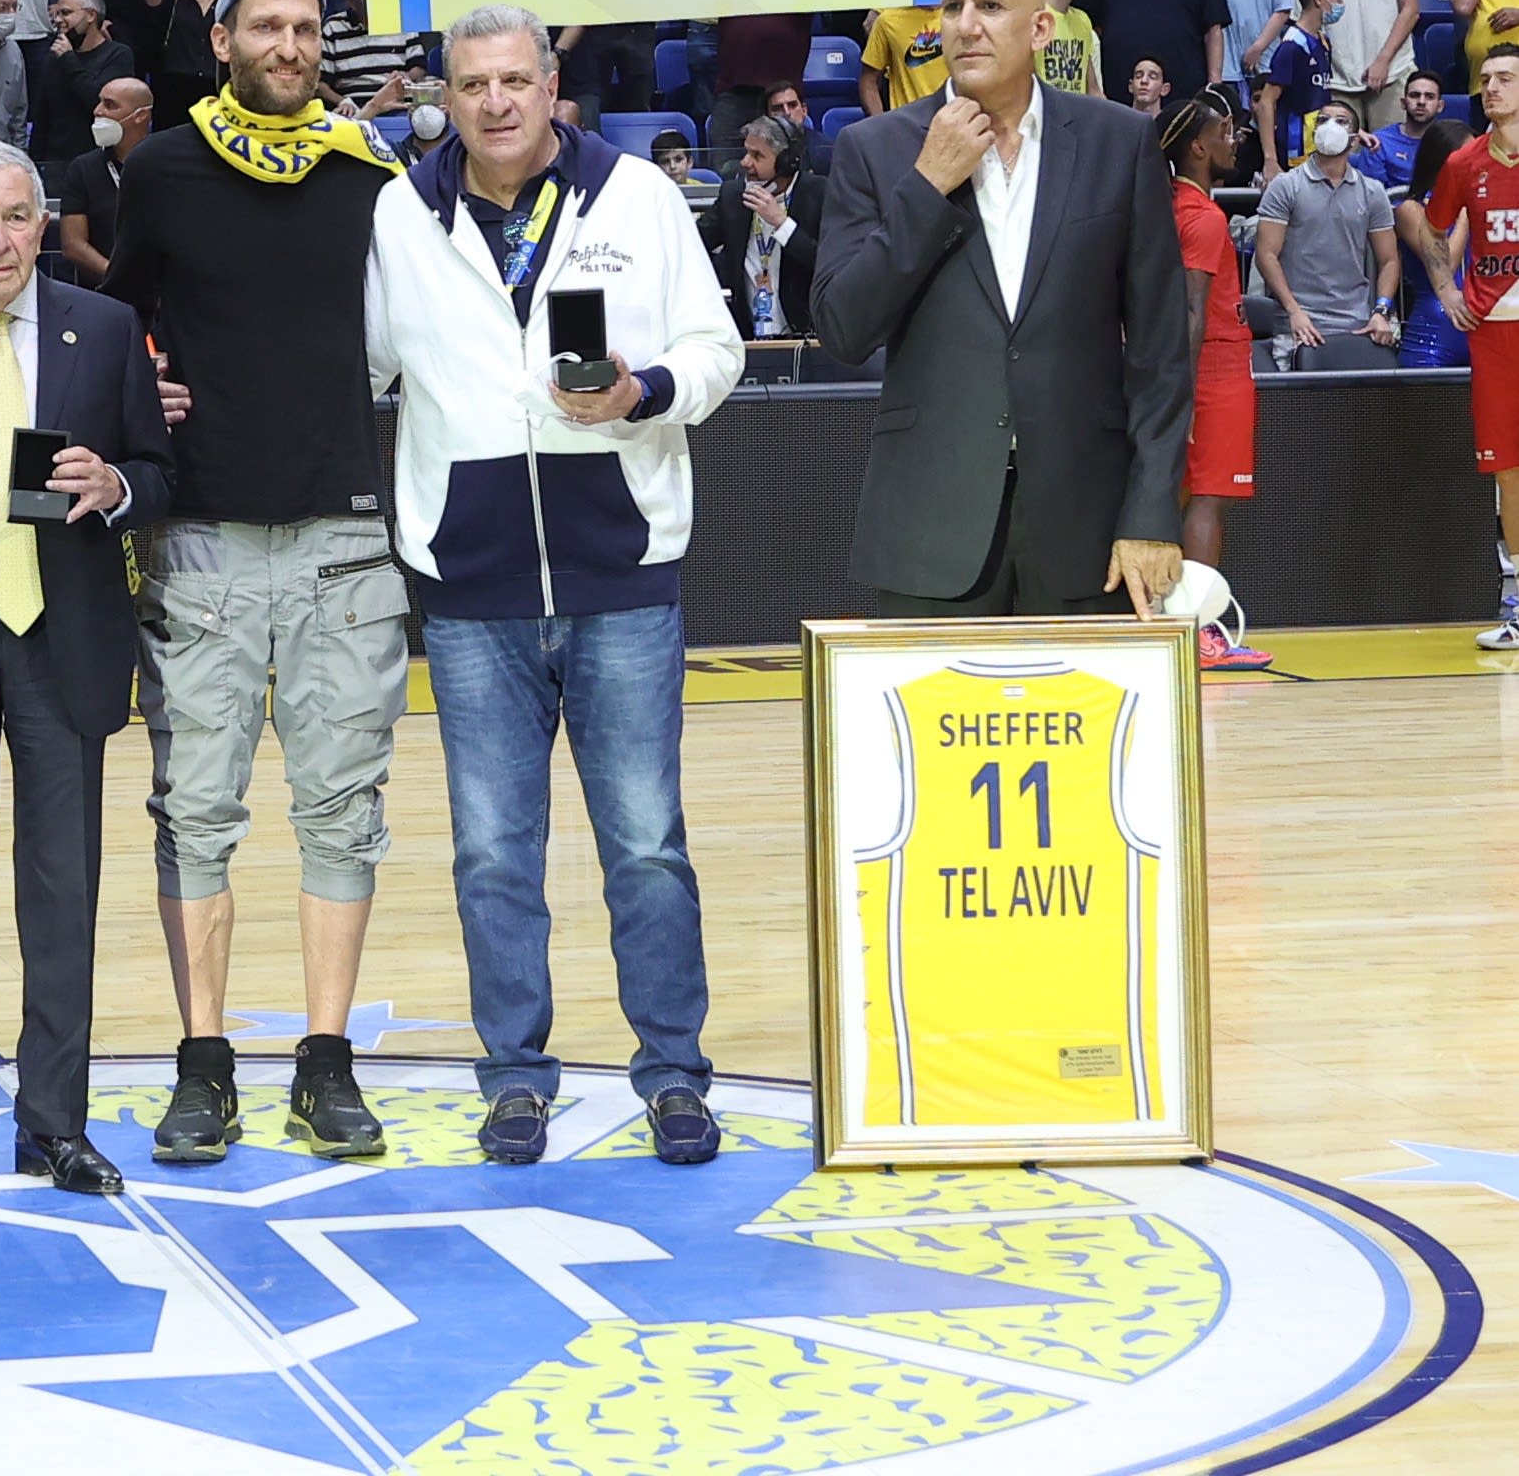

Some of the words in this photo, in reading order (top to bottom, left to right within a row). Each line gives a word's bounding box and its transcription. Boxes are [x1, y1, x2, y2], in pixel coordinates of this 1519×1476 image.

[1486, 209, 1519, 243] 33
[568, 244, 599, 266] Ralph
[601, 242, 633, 265] Lauren
[580, 264, 599, 273] POLO
[601, 264, 623, 272] TEAM
[939, 711, 1084, 748] SHEFFER
[970, 760, 1052, 850] 11
[938, 866, 998, 919] TEL
[1009, 864, 1094, 917] AVIV
